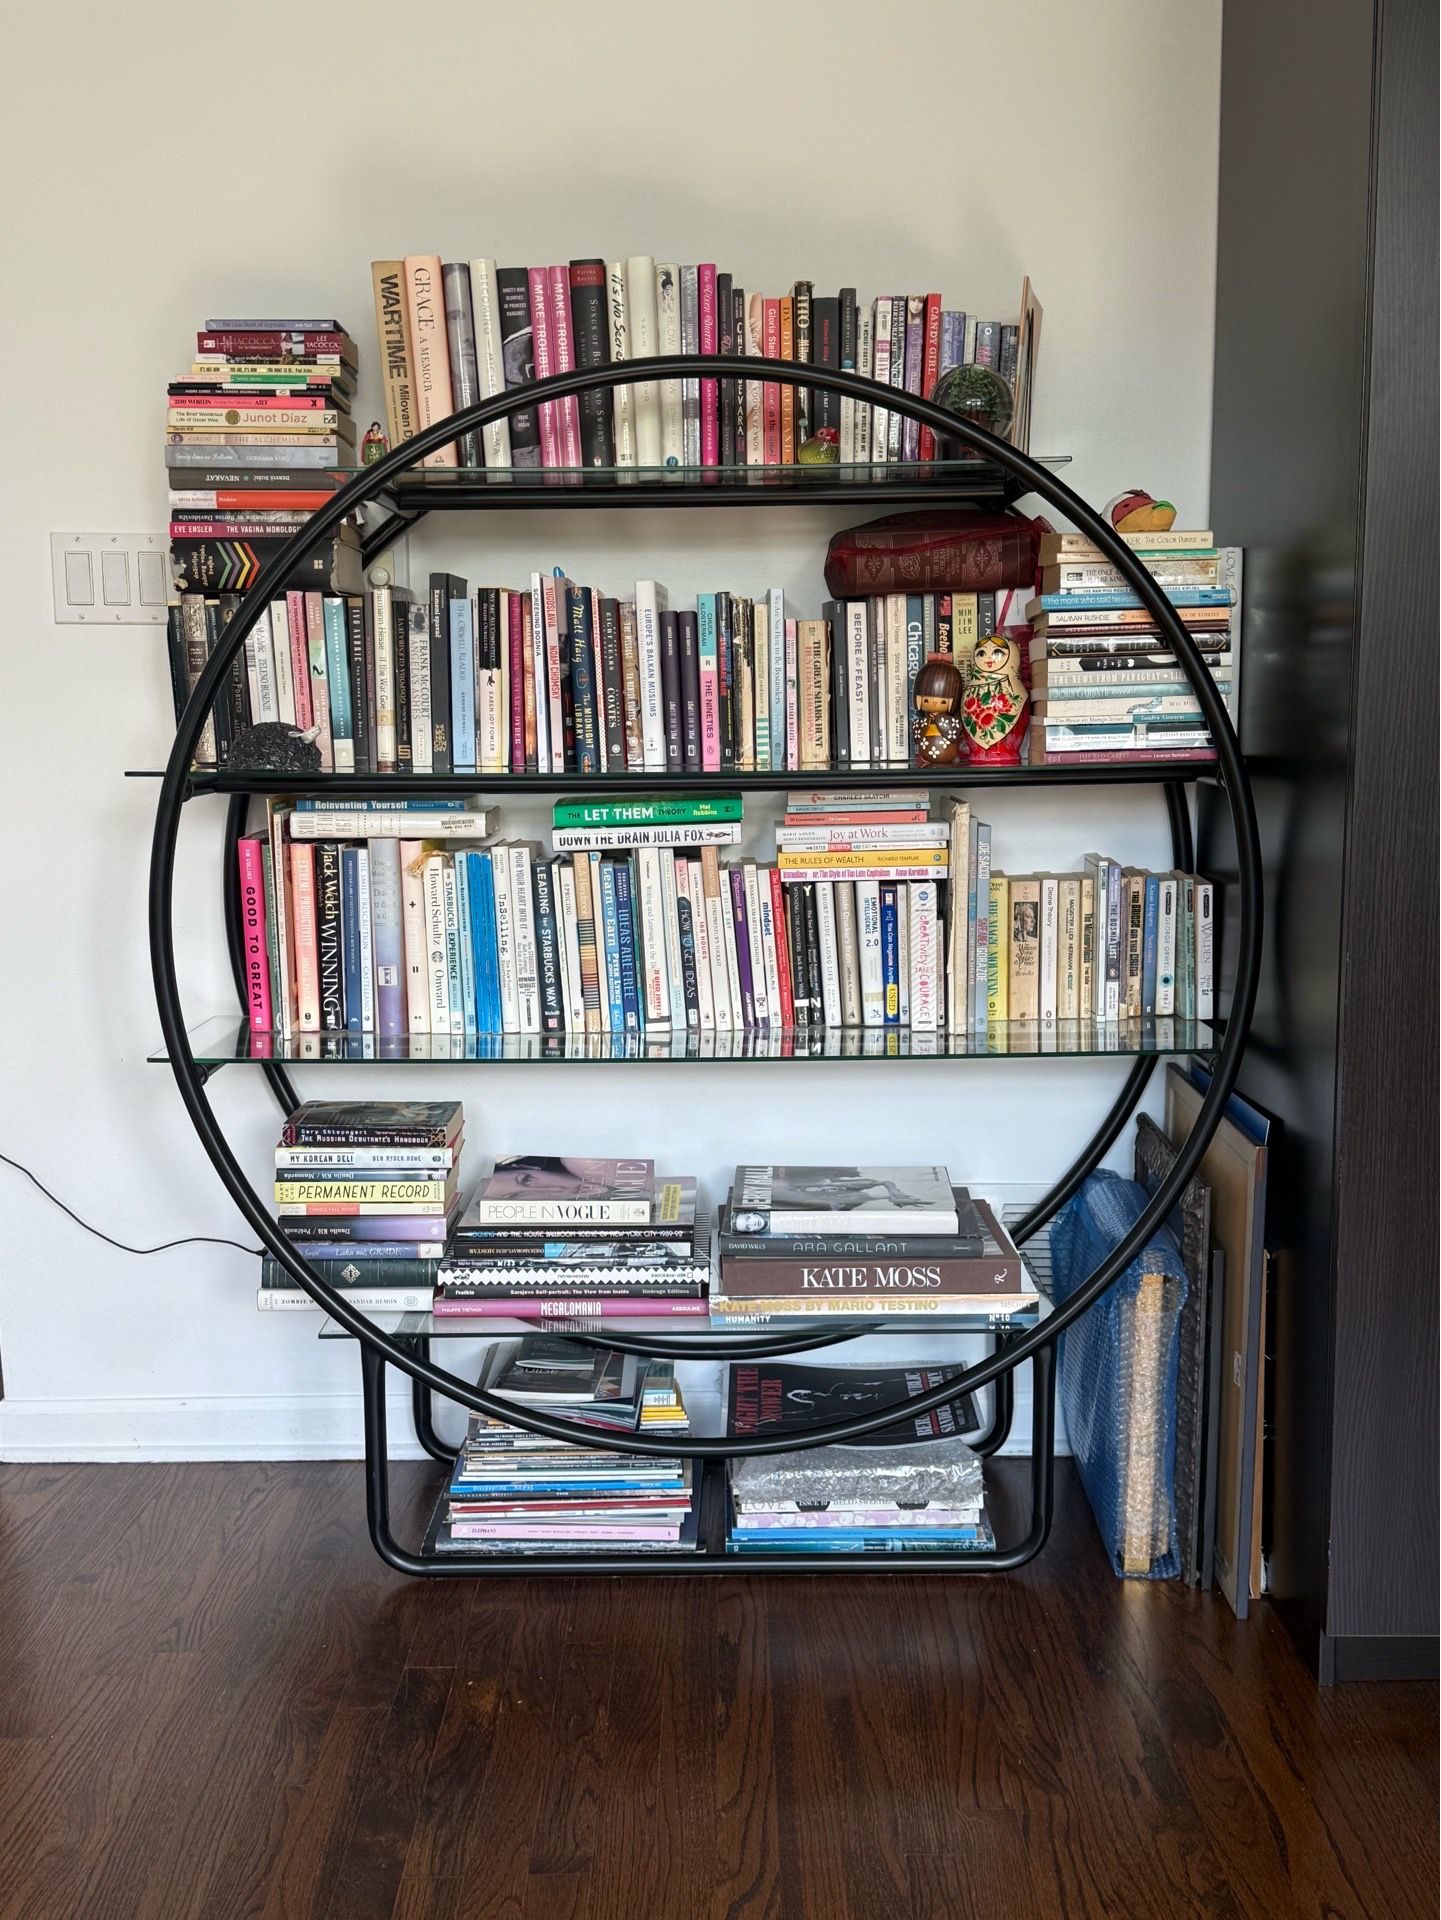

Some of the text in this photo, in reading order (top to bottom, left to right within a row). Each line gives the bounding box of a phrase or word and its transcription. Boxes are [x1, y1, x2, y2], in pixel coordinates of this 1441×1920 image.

[414, 268, 434, 330] GRACE
[480, 274, 491, 335] BECOMING
[554, 283, 567, 317] MAKE
[797, 294, 809, 328] TITO
[381, 274, 407, 379] WARTIME
[534, 284, 549, 379] MAKE TROUBLE
[768, 308, 776, 335] Gloria
[928, 306, 938, 375] CANDY GIRL
[420, 347, 430, 392] MEMOIR
[243, 413, 307, 424] Junot Díaz
[399, 385, 409, 427] Milovan
[546, 587, 560, 699] YUGOSLAVIA NOAM CHOMSKY
[572, 605, 585, 663] Matt Haig
[854, 613, 862, 654] BEFORE
[907, 622, 922, 679] Chicago
[939, 623, 950, 653] Beebo
[411, 640, 420, 720] ANGELA'S ASHES
[420, 640, 429, 719] FRANK McCOURT
[645, 609, 656, 717] EUROPE'S BALKAN MUSLIMS
[1053, 673, 1161, 684] THE NEWS FROM PARAGUAY
[855, 668, 863, 703] FEAST
[574, 703, 583, 740] LIBRARY
[607, 688, 616, 728] COATES
[706, 699, 714, 738] NINETIES
[584, 708, 593, 749] MIDNIGHT
[315, 801, 407, 809] Reinventing Yourself
[584, 810, 609, 821] LET
[614, 808, 653, 820] THEM
[657, 808, 686, 816] THEORY
[653, 830, 704, 843] JULIA FOX
[830, 827, 888, 842] Joy at Work
[979, 841, 989, 879] JOE SACCO
[321, 851, 339, 919] Jack Welch
[429, 868, 442, 945] Howard Schultz
[603, 867, 617, 947] Learn to Earn
[762, 902, 772, 936] mindset
[245, 886, 262, 1010] GOOD TO GREAT
[446, 882, 457, 980] STARBUCKS EXPERIENCE
[537, 867, 556, 1007] LEADING STARBUCKS WAY
[866, 939, 879, 947] 2.0
[321, 922, 339, 1011] WINNING
[618, 909, 634, 999] IDEAS ARE FREE
[681, 909, 695, 998] HOW TO GET IDEAS
[1109, 944, 1117, 960] LIST
[435, 969, 445, 1009] Onward
[298, 1185, 430, 1199] PERMANENT RECORD
[742, 1167, 773, 1210] JERRY HALL
[488, 1206, 537, 1218] PEOPLE
[542, 1206, 555, 1218] IN
[556, 1206, 611, 1220] VOGUE
[793, 1243, 908, 1252] ARA GALLANT
[800, 1266, 941, 1289] KATE MOSS
[541, 1302, 602, 1316] MEGALOMANIA
[719, 1300, 938, 1312] KATE MOSS BY MARIO TESTINO
[737, 1368, 759, 1393] THE
